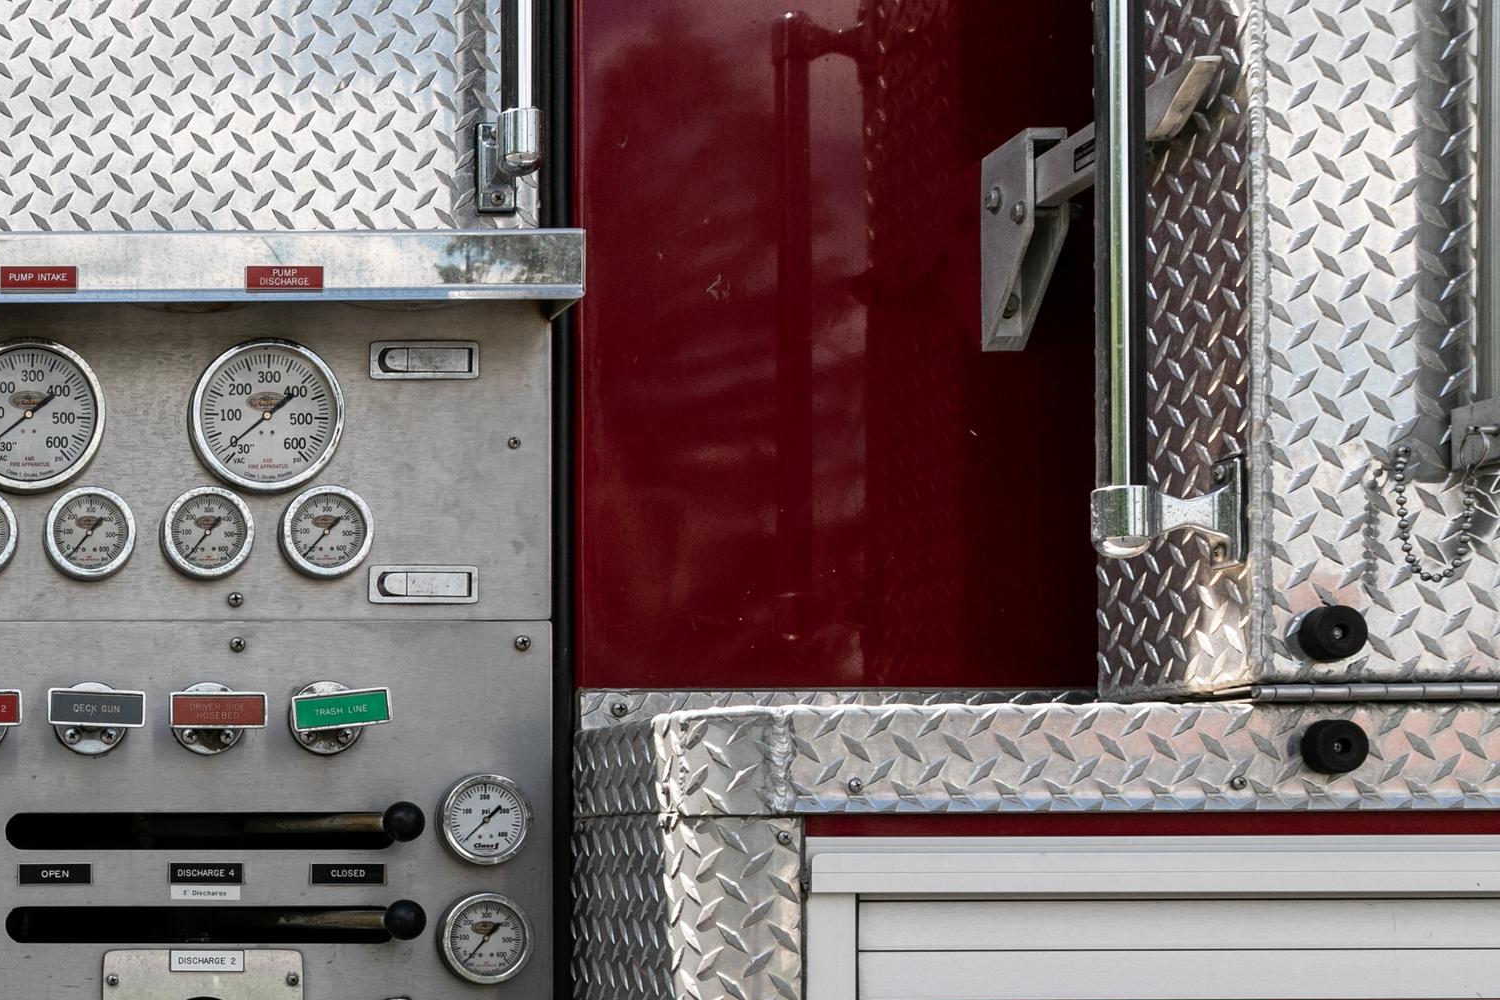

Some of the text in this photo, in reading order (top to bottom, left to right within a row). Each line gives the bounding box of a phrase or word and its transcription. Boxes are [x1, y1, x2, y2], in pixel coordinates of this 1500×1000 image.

[9, 273, 68, 281] PUMP INTAKE
[272, 269, 297, 277] PUMP
[259, 277, 310, 286] DISCHARGE
[21, 370, 44, 382] 300
[258, 371, 281, 383] 300
[47, 385, 70, 397] 400
[229, 383, 252, 395] 200
[284, 386, 307, 397] 400
[52, 412, 75, 424] 500
[220, 409, 242, 421] 100
[290, 413, 313, 425] 500
[46, 436, 68, 448] 600
[230, 435, 238, 447] 0
[284, 438, 306, 449] 600
[0, 705, 7, 713] 2
[73, 704, 120, 714] DECK GUN
[189, 702, 245, 711] DRIVER SIDE
[315, 704, 368, 716] TRASH LINE
[196, 711, 240, 720] HOSEBED
[41, 870, 69, 878] OPEN
[177, 869, 235, 877] DISCHARGE 4
[331, 869, 365, 878] CLOSED
[192, 889, 227, 897] Discharge
[178, 957, 236, 965] DISCHARGE 2
